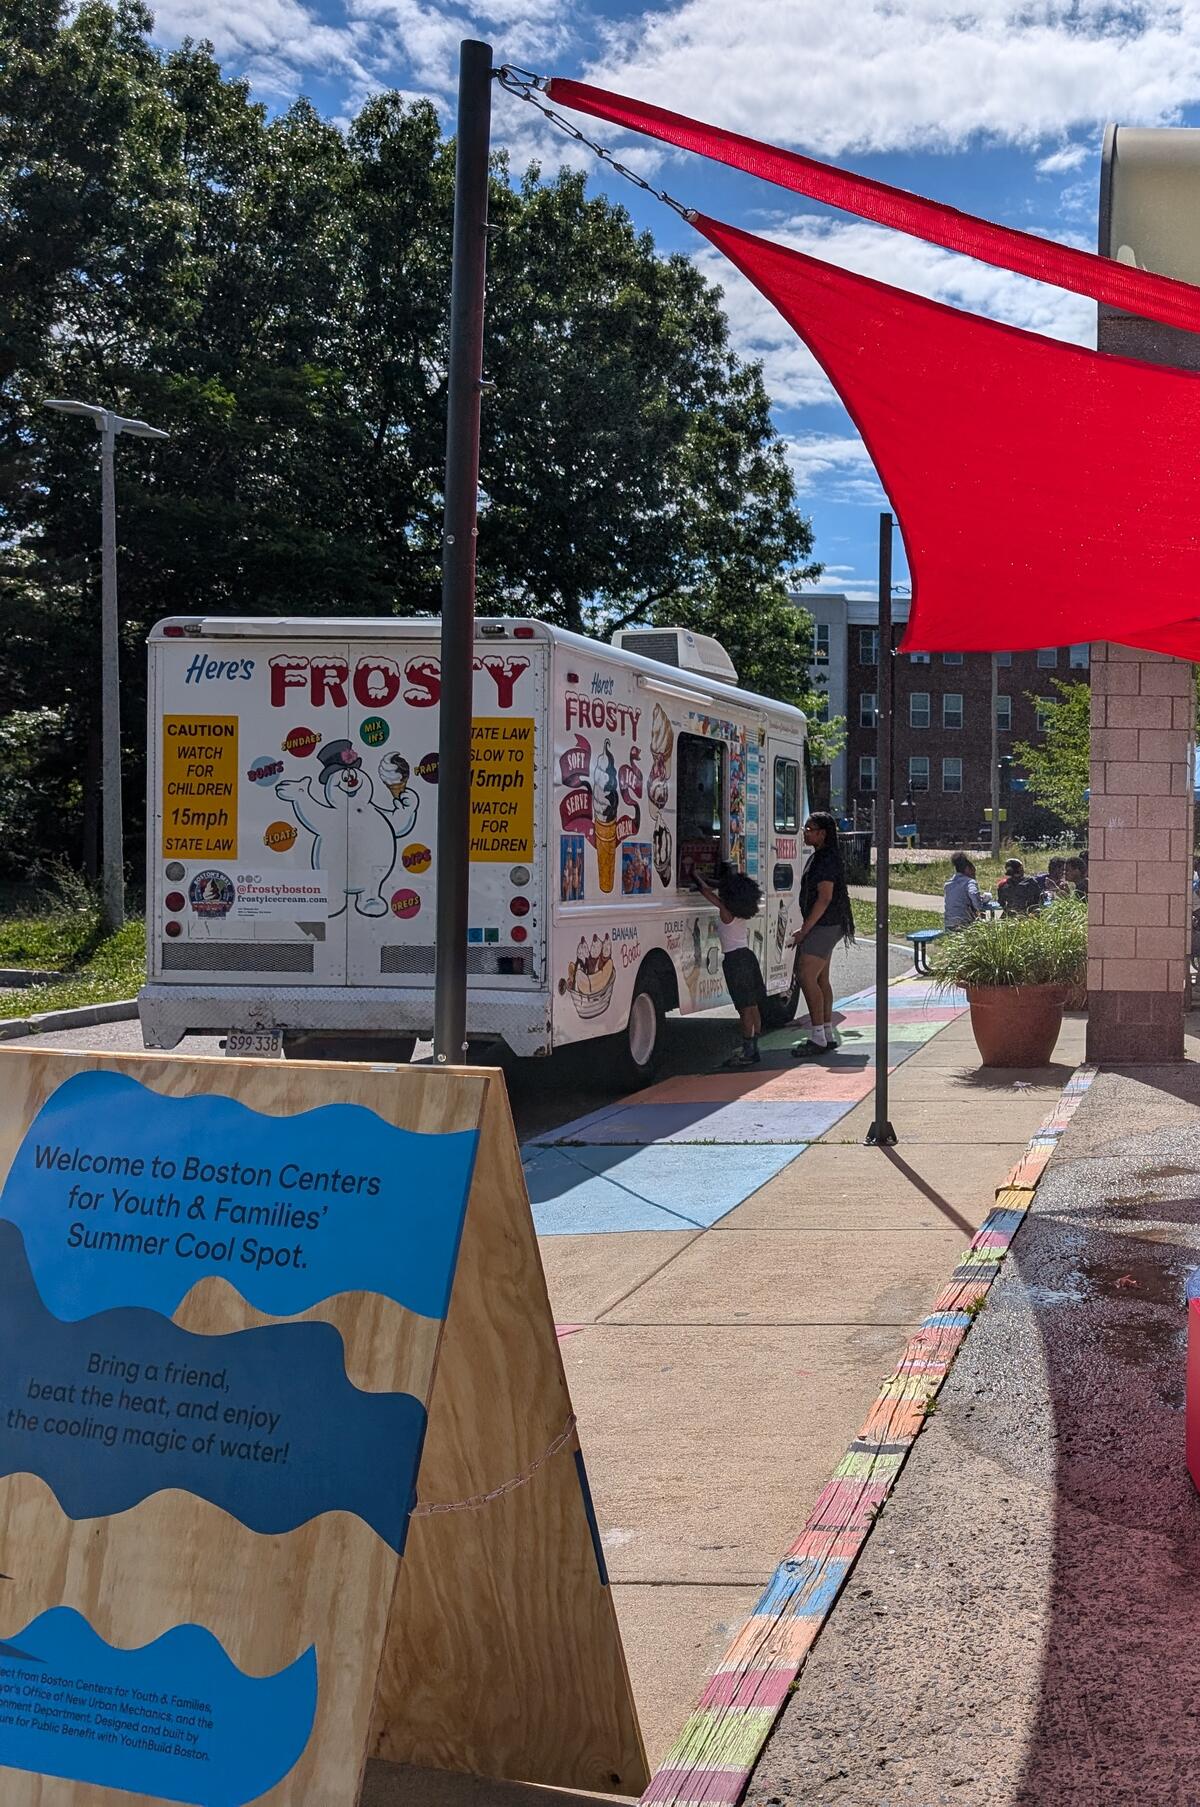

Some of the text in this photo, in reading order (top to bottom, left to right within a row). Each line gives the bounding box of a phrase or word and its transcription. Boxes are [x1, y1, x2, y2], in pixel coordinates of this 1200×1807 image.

[186, 654, 255, 685] Here's
[269, 654, 530, 708] FROSY
[591, 672, 613, 695] Here's
[565, 691, 641, 742] FROSTY
[167, 724, 235, 737] CAUTION
[364, 721, 384, 734] MIX
[470, 727, 530, 740] TATE LAW
[281, 731, 322, 752] SUNDAES
[177, 746, 223, 760] WATCH
[469, 749, 524, 762] SLOW TO
[567, 752, 585, 770] SOFT
[187, 765, 214, 778] FOR
[247, 760, 284, 782] BOATS
[414, 762, 440, 776] FRAP
[625, 770, 637, 789] ICE
[167, 782, 232, 796] CHILDREN
[470, 769, 524, 792] 15mph
[472, 802, 518, 815] WATCH
[566, 793, 588, 815] SERVE
[171, 808, 228, 830] 15mph
[481, 820, 508, 833] FOR
[264, 826, 298, 848] FLOATS
[617, 821, 633, 840] CREAM
[165, 838, 233, 852] STATE LAW
[470, 839, 528, 852] HILDREN
[402, 848, 432, 867] DIPS
[237, 885, 321, 895] @frostyboston
[391, 895, 421, 912] OREOS
[612, 927, 638, 941] BANANA
[664, 920, 684, 934] DOUBLE
[620, 943, 642, 968] Boat
[34, 1145, 381, 1196] Welcome to Boston Centers
[67, 1185, 104, 1211] for
[112, 1188, 180, 1218] Youth
[187, 1196, 206, 1220] &
[67, 1223, 308, 1271] Summer Cool Spot.
[87, 1353, 230, 1392] Bring a friend,
[27, 1379, 281, 1434] beat the heat, and enjoy
[6, 1409, 290, 1465] the cooling magic of water!
[0, 1667, 212, 1714] ect from Boston Centers for Youth & Families,
[22, 1686, 52, 1701] Office
[53, 1691, 64, 1703] of
[66, 1694, 86, 1708] New
[88, 1697, 118, 1712] Urban
[176, 1714, 195, 1727] and
[197, 1717, 214, 1730] the
[0, 1714, 210, 1761] ure for Public Benefit with YouthBuild Boston.
[95, 1714, 139, 1733] Designed
[141, 1722, 160, 1736] and
[163, 1725, 183, 1741] built
[186, 1730, 199, 1745] by
